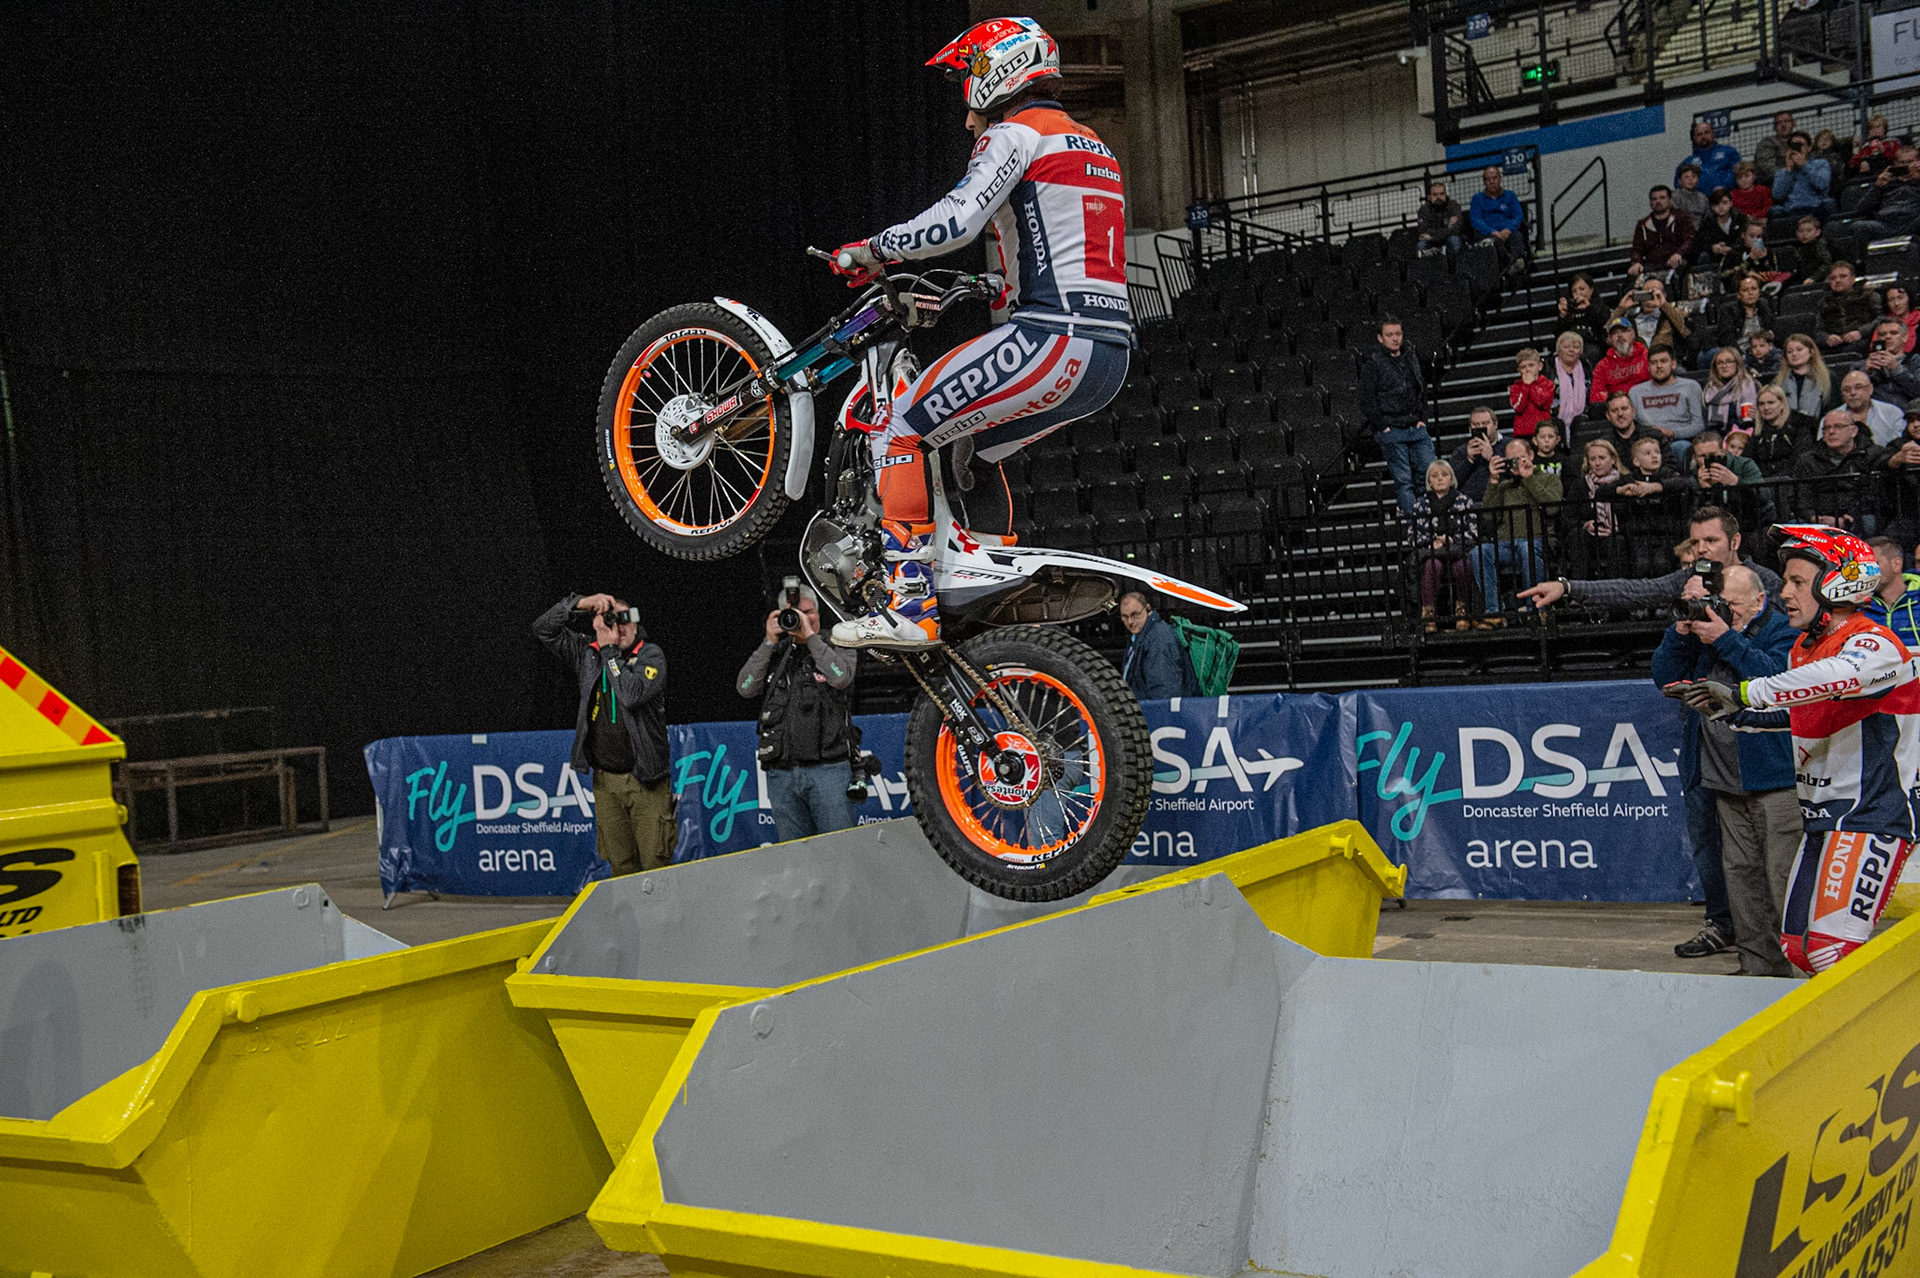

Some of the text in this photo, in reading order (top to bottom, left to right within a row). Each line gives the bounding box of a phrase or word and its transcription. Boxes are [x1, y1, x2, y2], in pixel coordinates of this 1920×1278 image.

[1006, 34, 1032, 47] SPEA
[974, 51, 1030, 107] hebo
[1065, 135, 1117, 159] REPSO
[1504, 152, 1525, 166] 120
[974, 148, 1020, 211] hebo
[1085, 162, 1121, 183] hebo
[1191, 209, 1208, 221] 120
[881, 214, 968, 252] REPSOL
[1023, 200, 1048, 277] HONDA
[1106, 225, 1115, 268] 1
[915, 301, 942, 312] RENTHAL
[922, 329, 1038, 425] REPSOL
[706, 396, 738, 424] SHOWA
[932, 411, 987, 445] hebo
[873, 453, 914, 471] ebo
[1774, 676, 1861, 703] HONDA
[951, 698, 968, 720] NGK
[957, 744, 975, 776] GALFER
[1149, 726, 1254, 795] SA
[674, 743, 759, 843] Fly
[1356, 721, 1668, 841] Fly DSA
[406, 760, 594, 852] Fly DSA
[1155, 797, 1206, 811] Sheffield
[1208, 798, 1255, 814] Airport
[1463, 802, 1668, 821] Doncaster Sheffield Airport
[477, 821, 593, 835] Doncaster Sheffield Airport
[1130, 830, 1198, 857] ena
[1466, 838, 1598, 869] arena
[478, 849, 557, 873] arena
[1895, 1152, 1919, 1204] LTD
